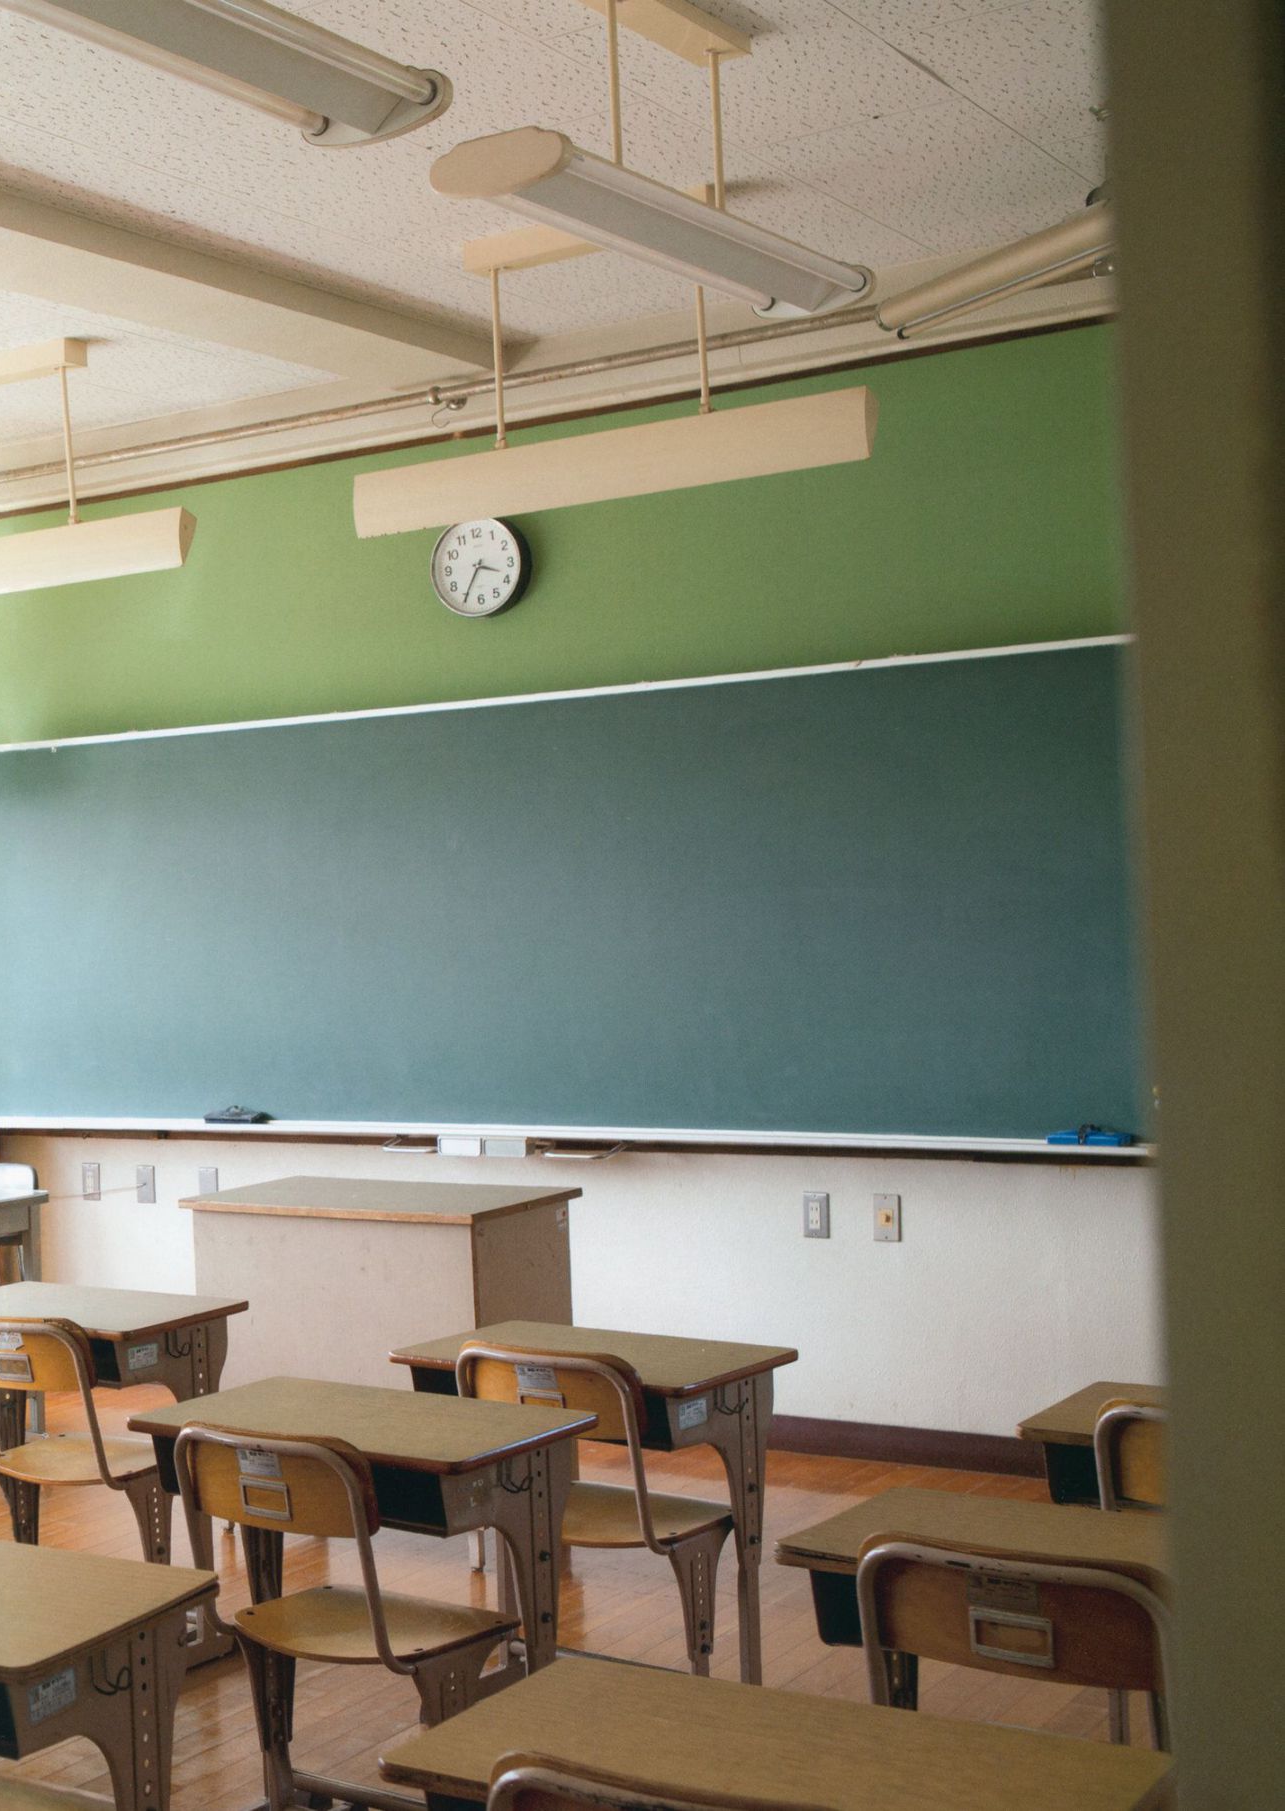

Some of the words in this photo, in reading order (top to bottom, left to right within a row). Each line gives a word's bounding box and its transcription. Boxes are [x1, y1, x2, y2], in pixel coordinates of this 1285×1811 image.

[471, 528, 482, 539] 12
[490, 531, 495, 540] 1
[457, 536, 466, 546] 11
[501, 540, 508, 551] 2
[447, 549, 459, 560] 10
[507, 556, 514, 567] 3
[445, 566, 452, 576] 9
[503, 574, 510, 584] 4
[450, 581, 458, 592] 8
[493, 588, 500, 599] 5
[477, 594, 485, 605] 6
